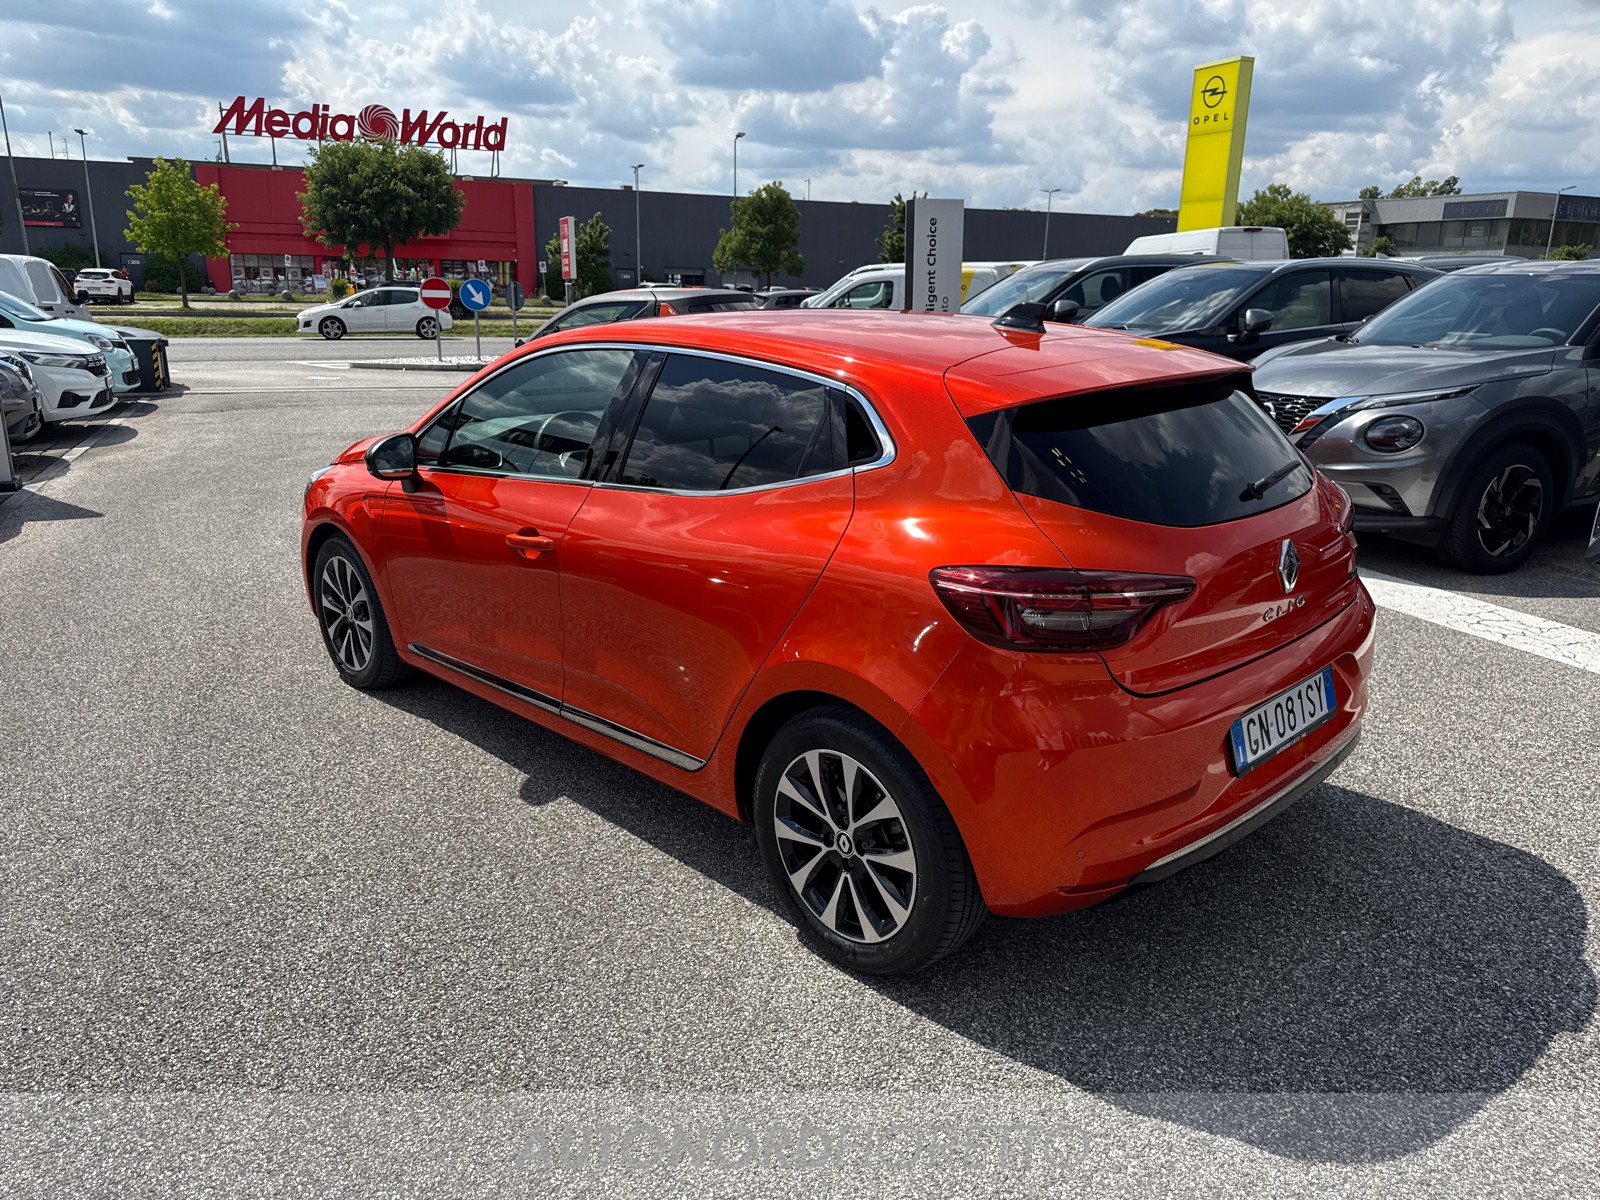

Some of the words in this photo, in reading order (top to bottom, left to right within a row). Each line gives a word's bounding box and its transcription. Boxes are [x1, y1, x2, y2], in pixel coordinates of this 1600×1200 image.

[212, 95, 355, 142] Media
[401, 108, 508, 151] World
[1193, 112, 1229, 125] OPEL
[926, 217, 938, 267] Choice
[925, 270, 938, 311] ligent
[1262, 594, 1306, 623] CLIO
